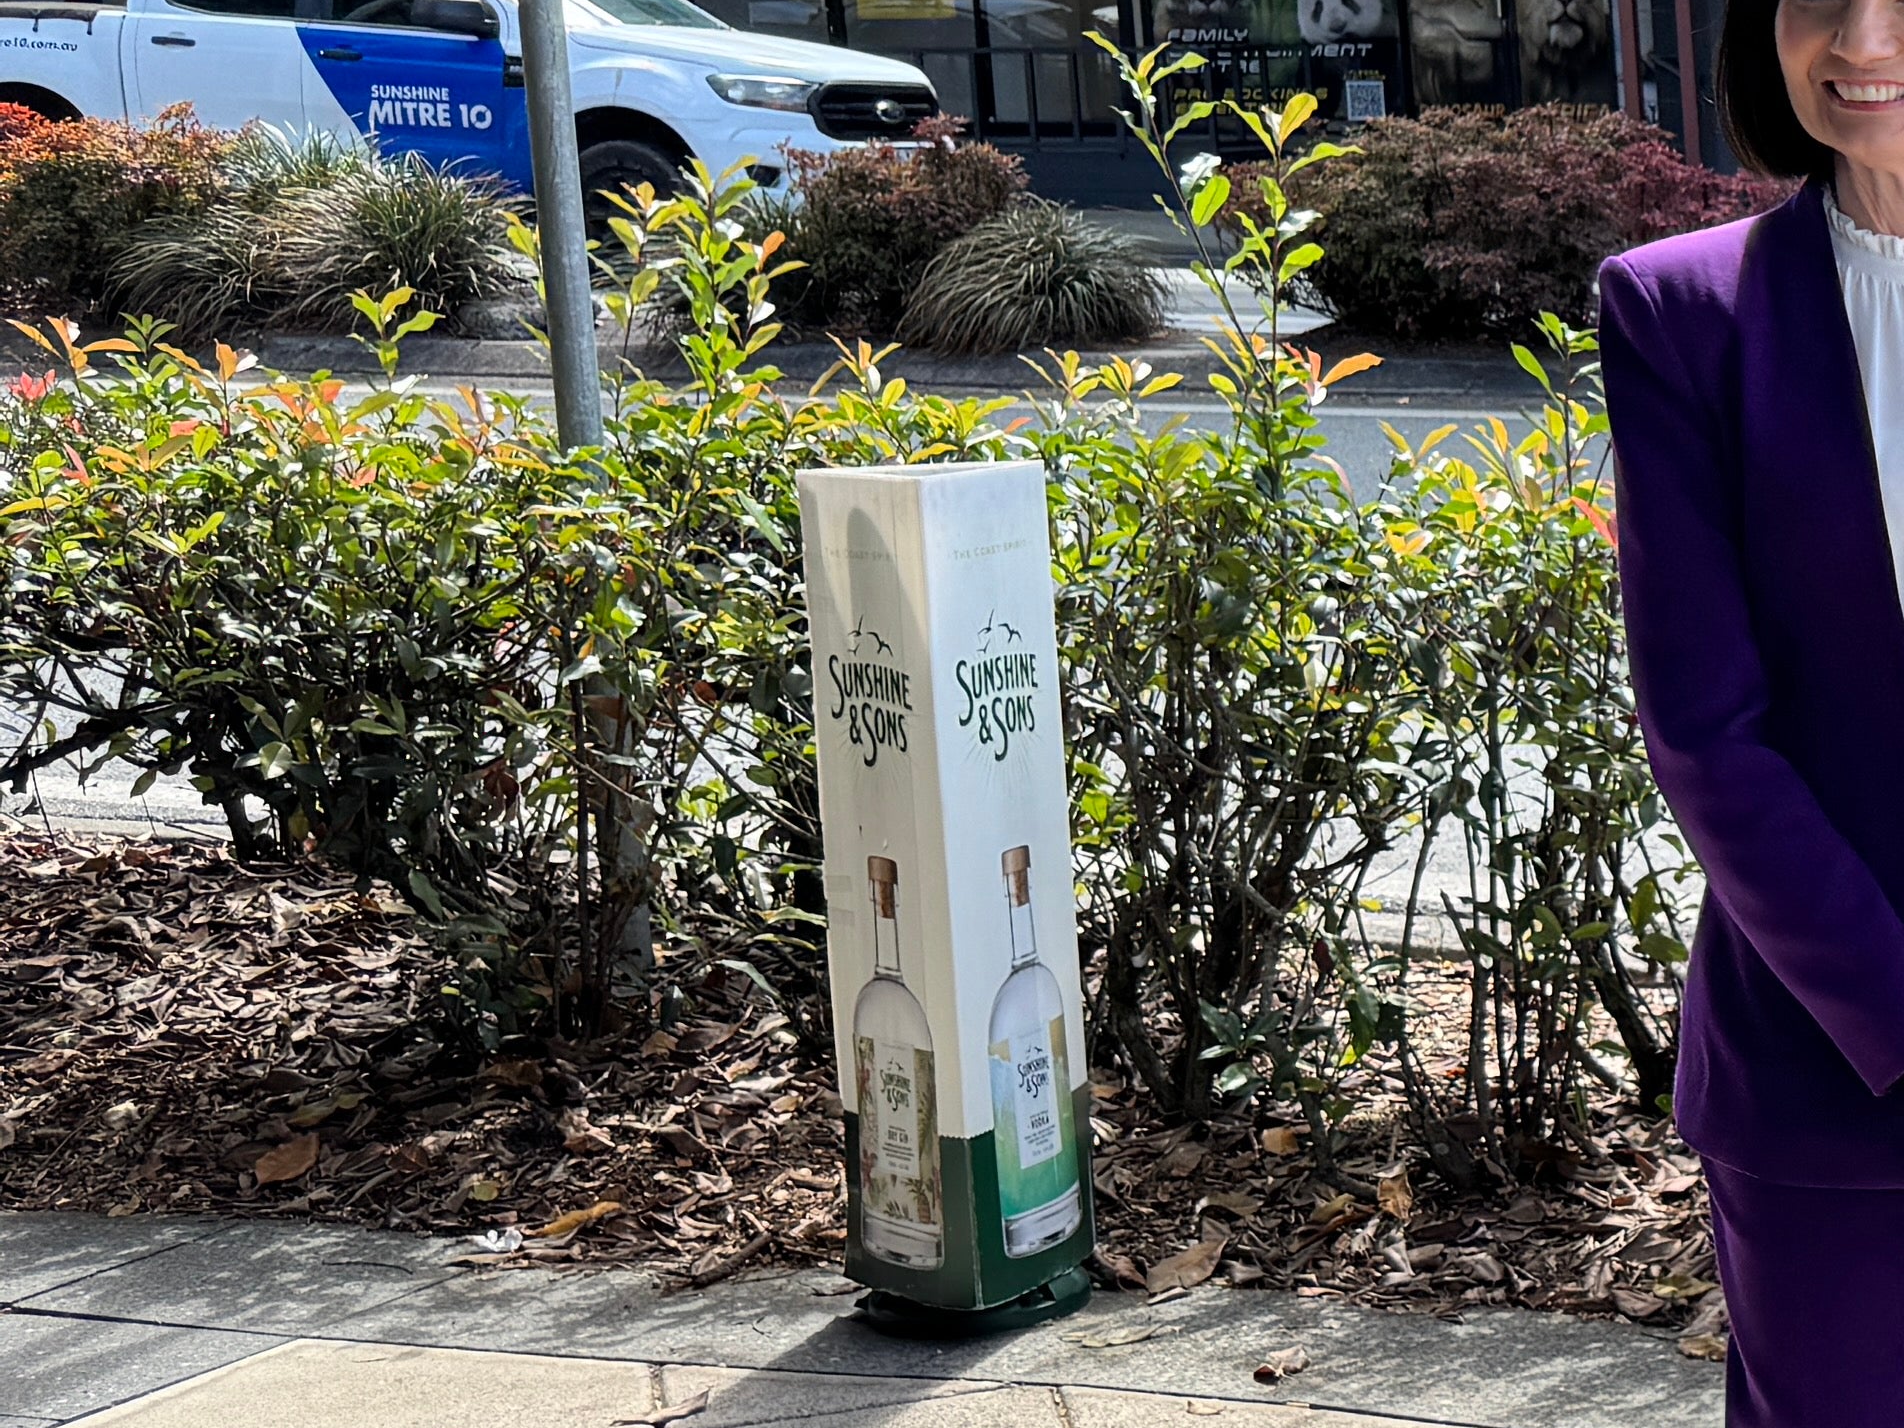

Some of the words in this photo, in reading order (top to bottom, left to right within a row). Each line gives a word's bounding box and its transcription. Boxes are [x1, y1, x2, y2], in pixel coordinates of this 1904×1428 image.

[369, 100, 451, 127] MITRE
[459, 104, 492, 129] 10
[371, 85, 450, 101] SUNSHINE
[829, 654, 912, 719] SUNSHINE
[956, 653, 1038, 726] SUNSHINE
